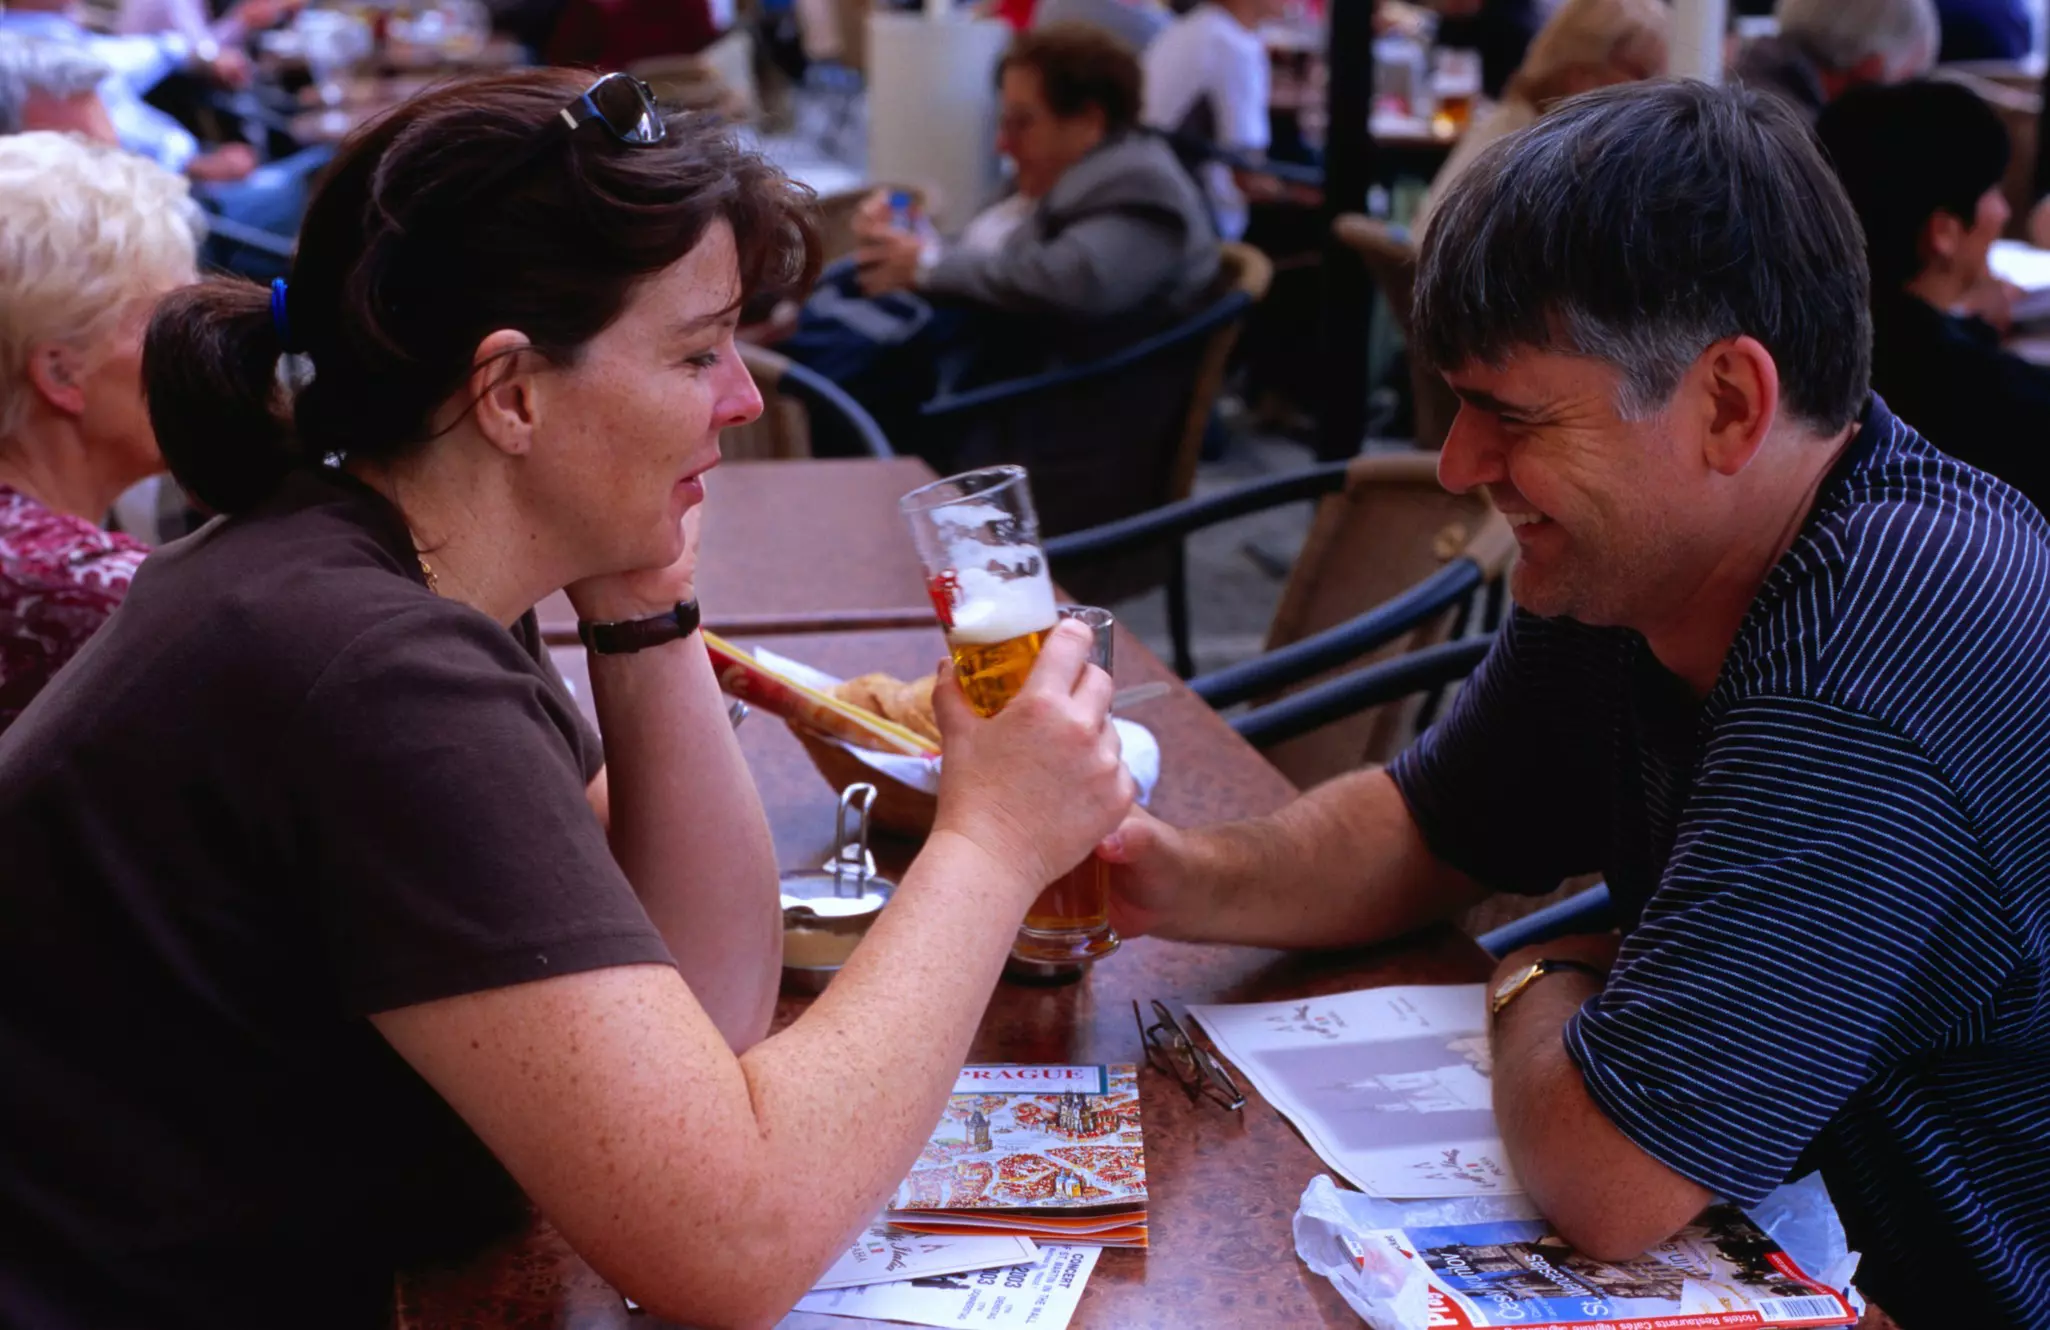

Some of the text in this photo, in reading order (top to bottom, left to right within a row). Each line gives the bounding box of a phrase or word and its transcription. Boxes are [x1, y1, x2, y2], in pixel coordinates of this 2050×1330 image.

[976, 1268, 1000, 1285] 003
[1004, 1266, 1030, 1288] 2003
[1059, 1253, 1084, 1289] CONCERT
[1655, 1315, 1720, 1328] Restaurants
[1722, 1313, 1757, 1324] Hotels
